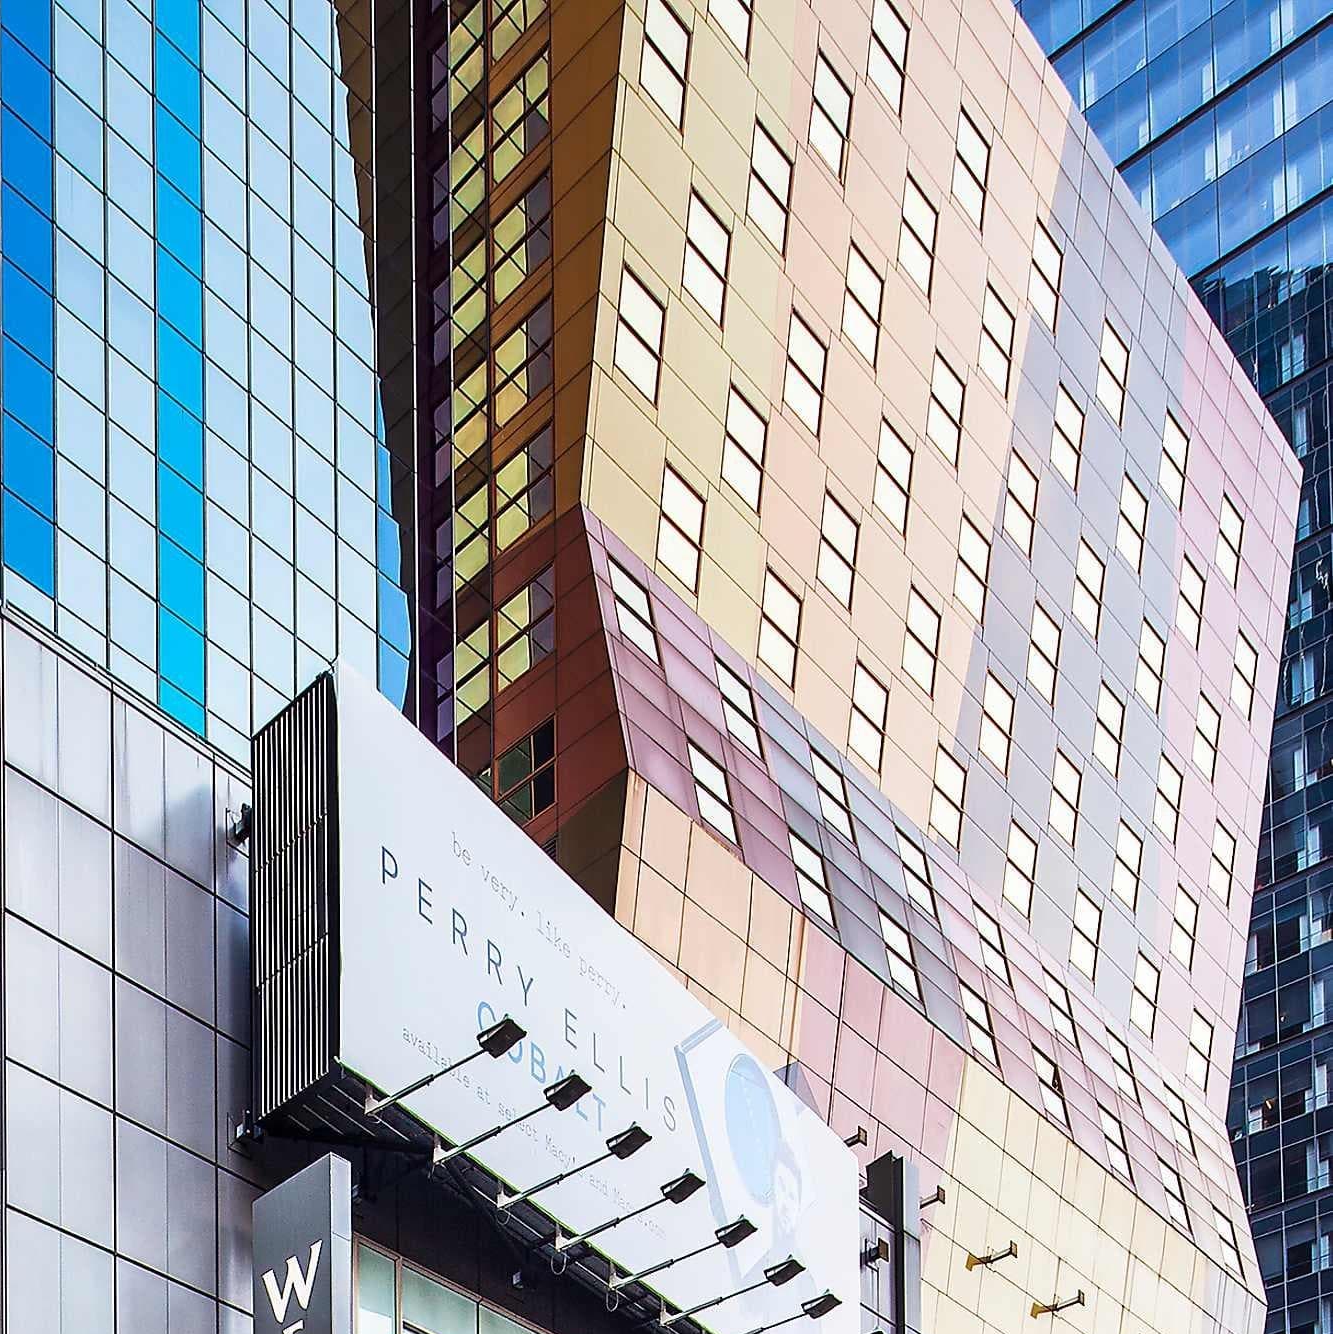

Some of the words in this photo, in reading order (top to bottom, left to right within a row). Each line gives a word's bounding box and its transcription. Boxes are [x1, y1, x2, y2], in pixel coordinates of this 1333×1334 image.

[451, 831, 472, 866] be
[480, 865, 525, 917] very.
[381, 845, 534, 1007] PERRY
[565, 1007, 676, 1132] ELLIS
